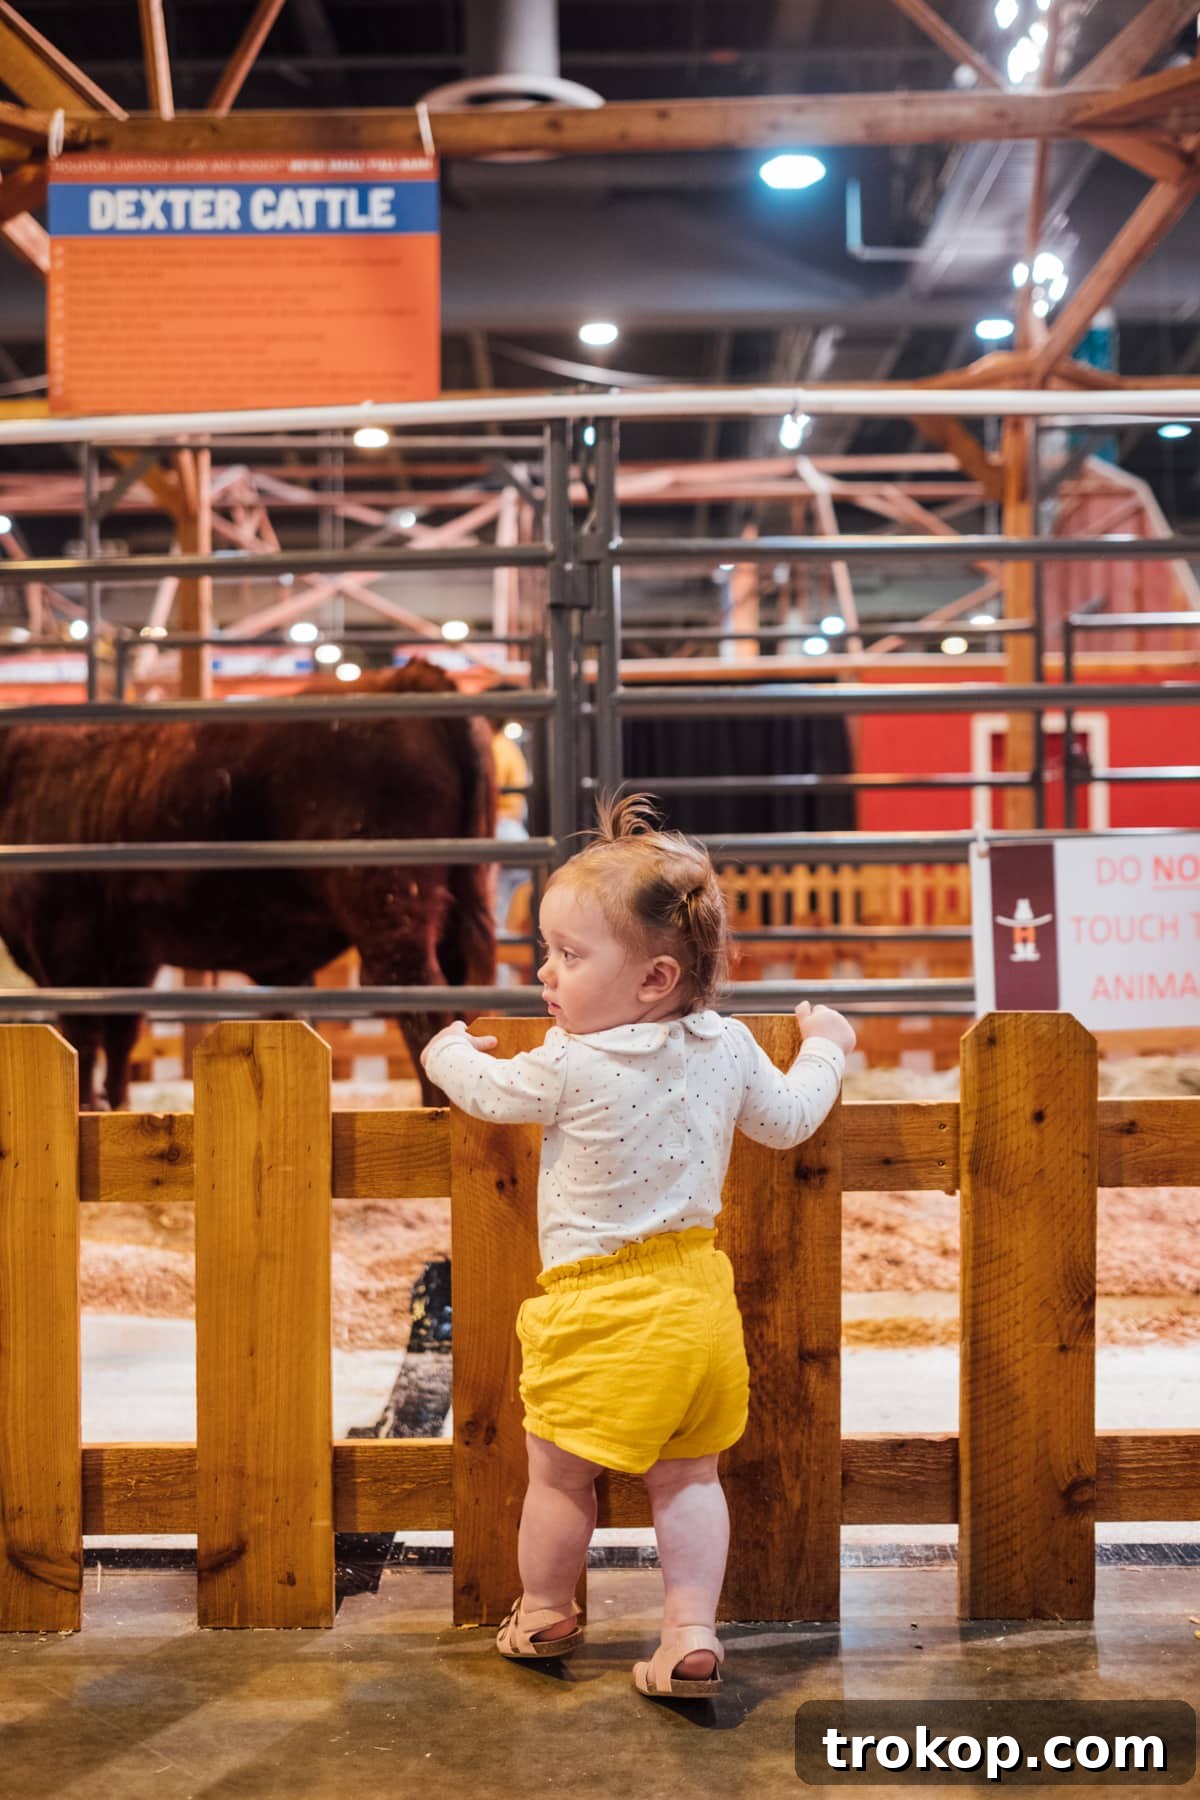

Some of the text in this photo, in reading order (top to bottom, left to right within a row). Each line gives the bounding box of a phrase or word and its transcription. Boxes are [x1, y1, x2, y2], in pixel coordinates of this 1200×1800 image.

[88, 187, 396, 231] DEXTER CATTLE
[1096, 855, 1142, 886] DO
[1070, 912, 1181, 945] TOUCH
[1091, 970, 1200, 1002] ANIMA
